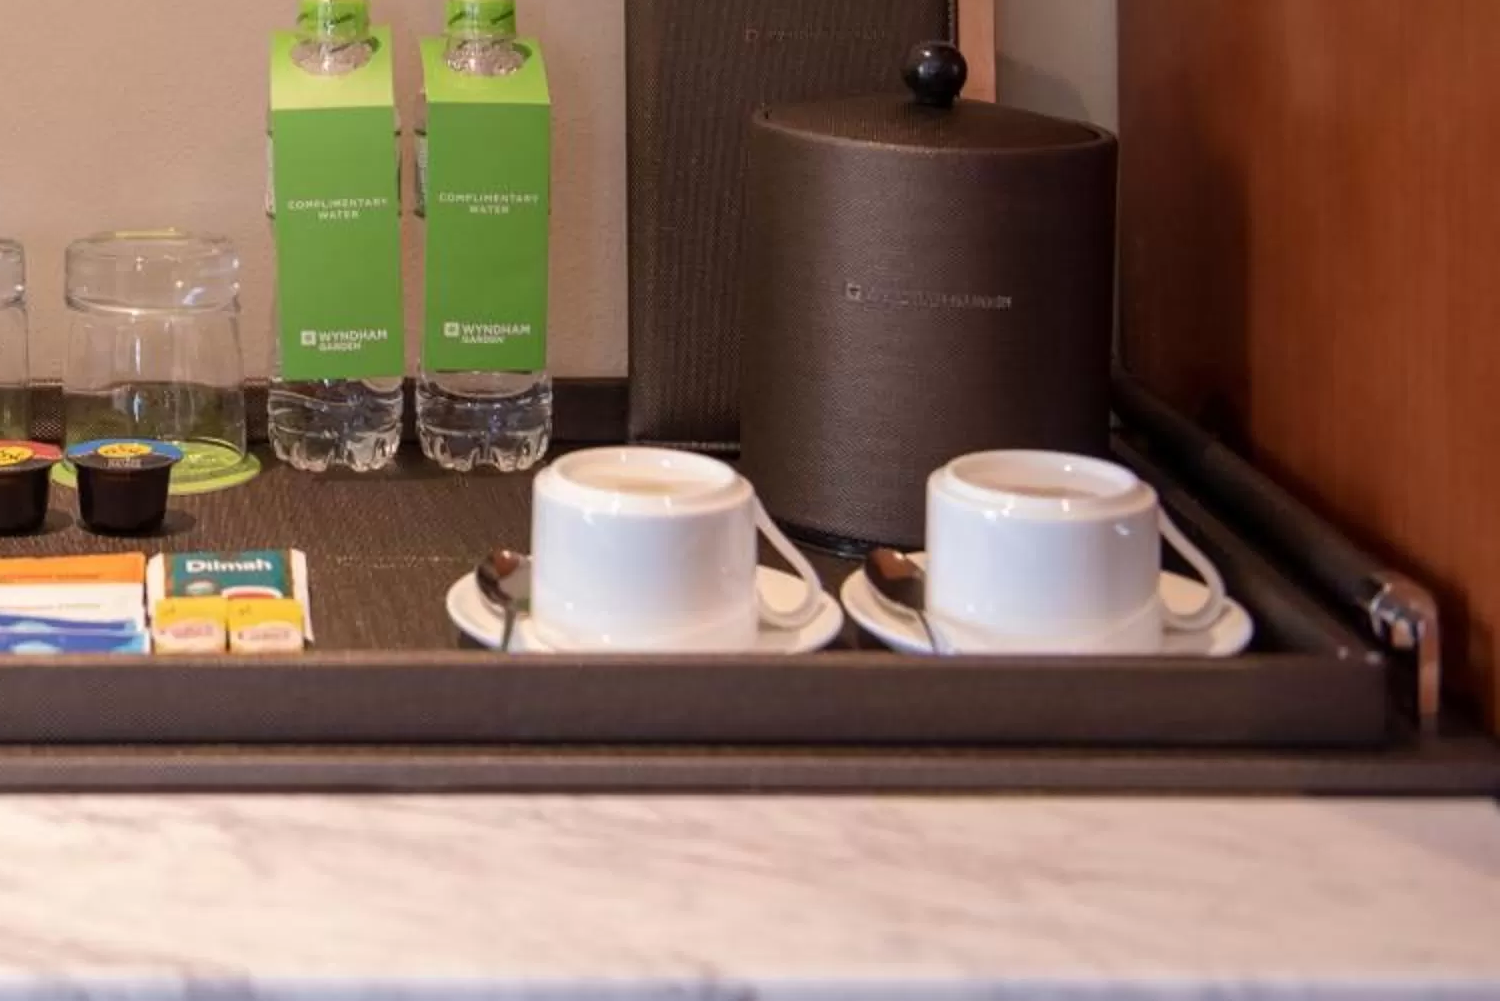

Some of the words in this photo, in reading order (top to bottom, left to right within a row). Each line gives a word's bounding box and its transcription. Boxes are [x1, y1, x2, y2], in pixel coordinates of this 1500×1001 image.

[288, 198, 387, 210] COMPLIMENTARY
[469, 205, 509, 215] WATER
[318, 210, 359, 220] WATER
[461, 323, 531, 335] WYNDHAM
[319, 329, 388, 342] WYNDHAM
[184, 559, 272, 574] Dilmah
